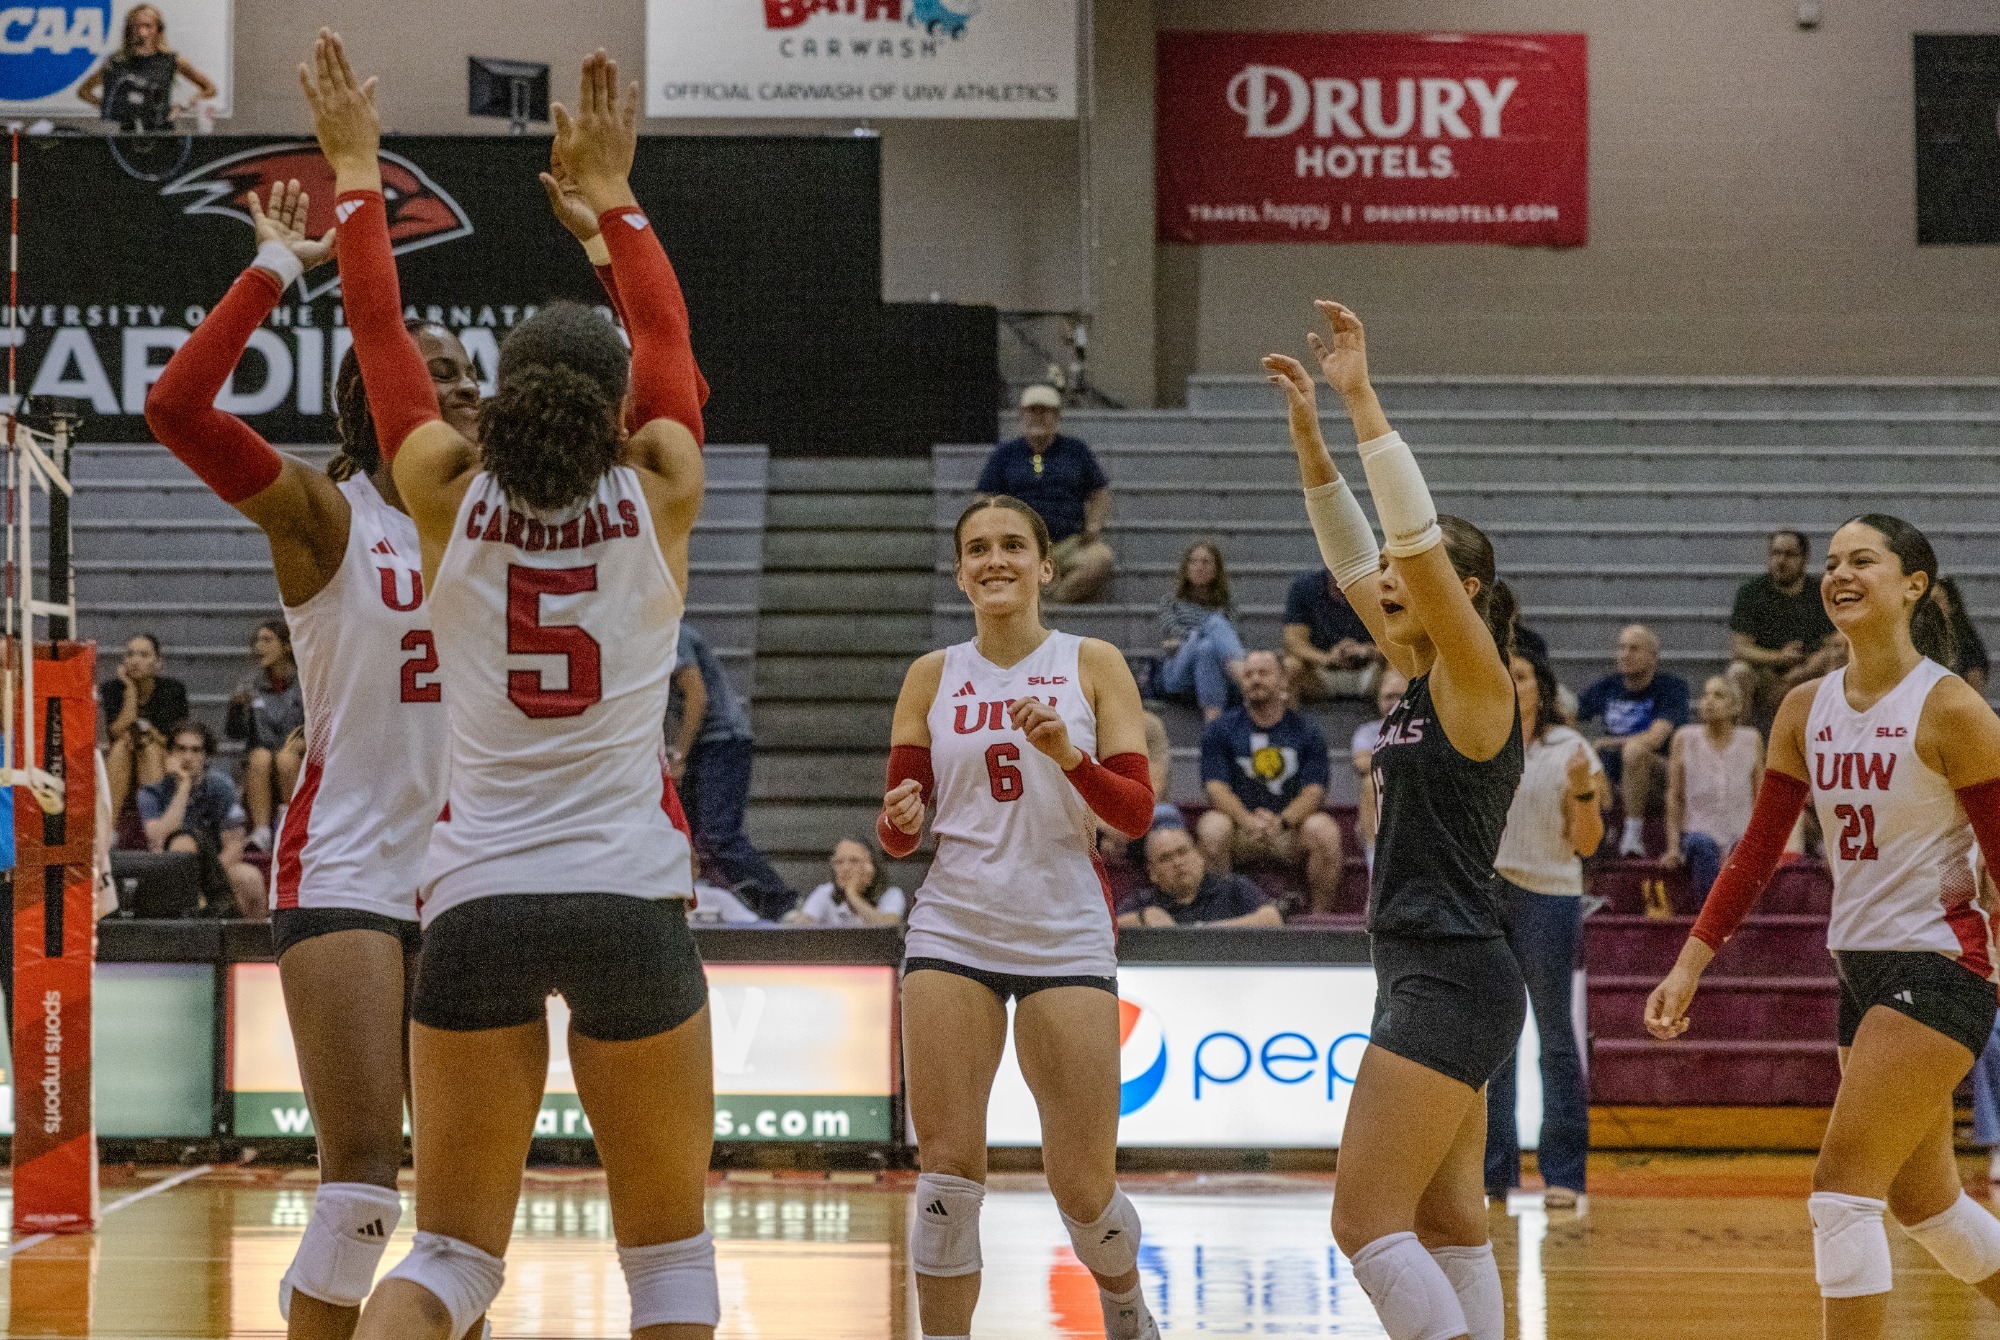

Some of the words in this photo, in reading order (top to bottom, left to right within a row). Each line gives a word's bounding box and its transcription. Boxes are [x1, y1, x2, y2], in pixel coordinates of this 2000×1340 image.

[779, 37, 937, 59] CARWASH
[664, 82, 749, 101] OFFICIAL
[758, 82, 864, 100] CARWASH
[869, 82, 894, 100] OF
[952, 82, 1058, 100] ATHLETICS
[1227, 64, 1517, 138] DRURY
[1296, 145, 1453, 178] HOTELS
[1262, 200, 1330, 230] happy
[466, 499, 639, 551] CARDINALS
[400, 629, 441, 703] 2
[506, 563, 602, 719] 5
[984, 742, 1024, 803] 6
[1815, 752, 1897, 791] UIW
[1834, 804, 1879, 861] 21
[43, 990, 63, 1053] sports
[41, 1056, 62, 1134] imports
